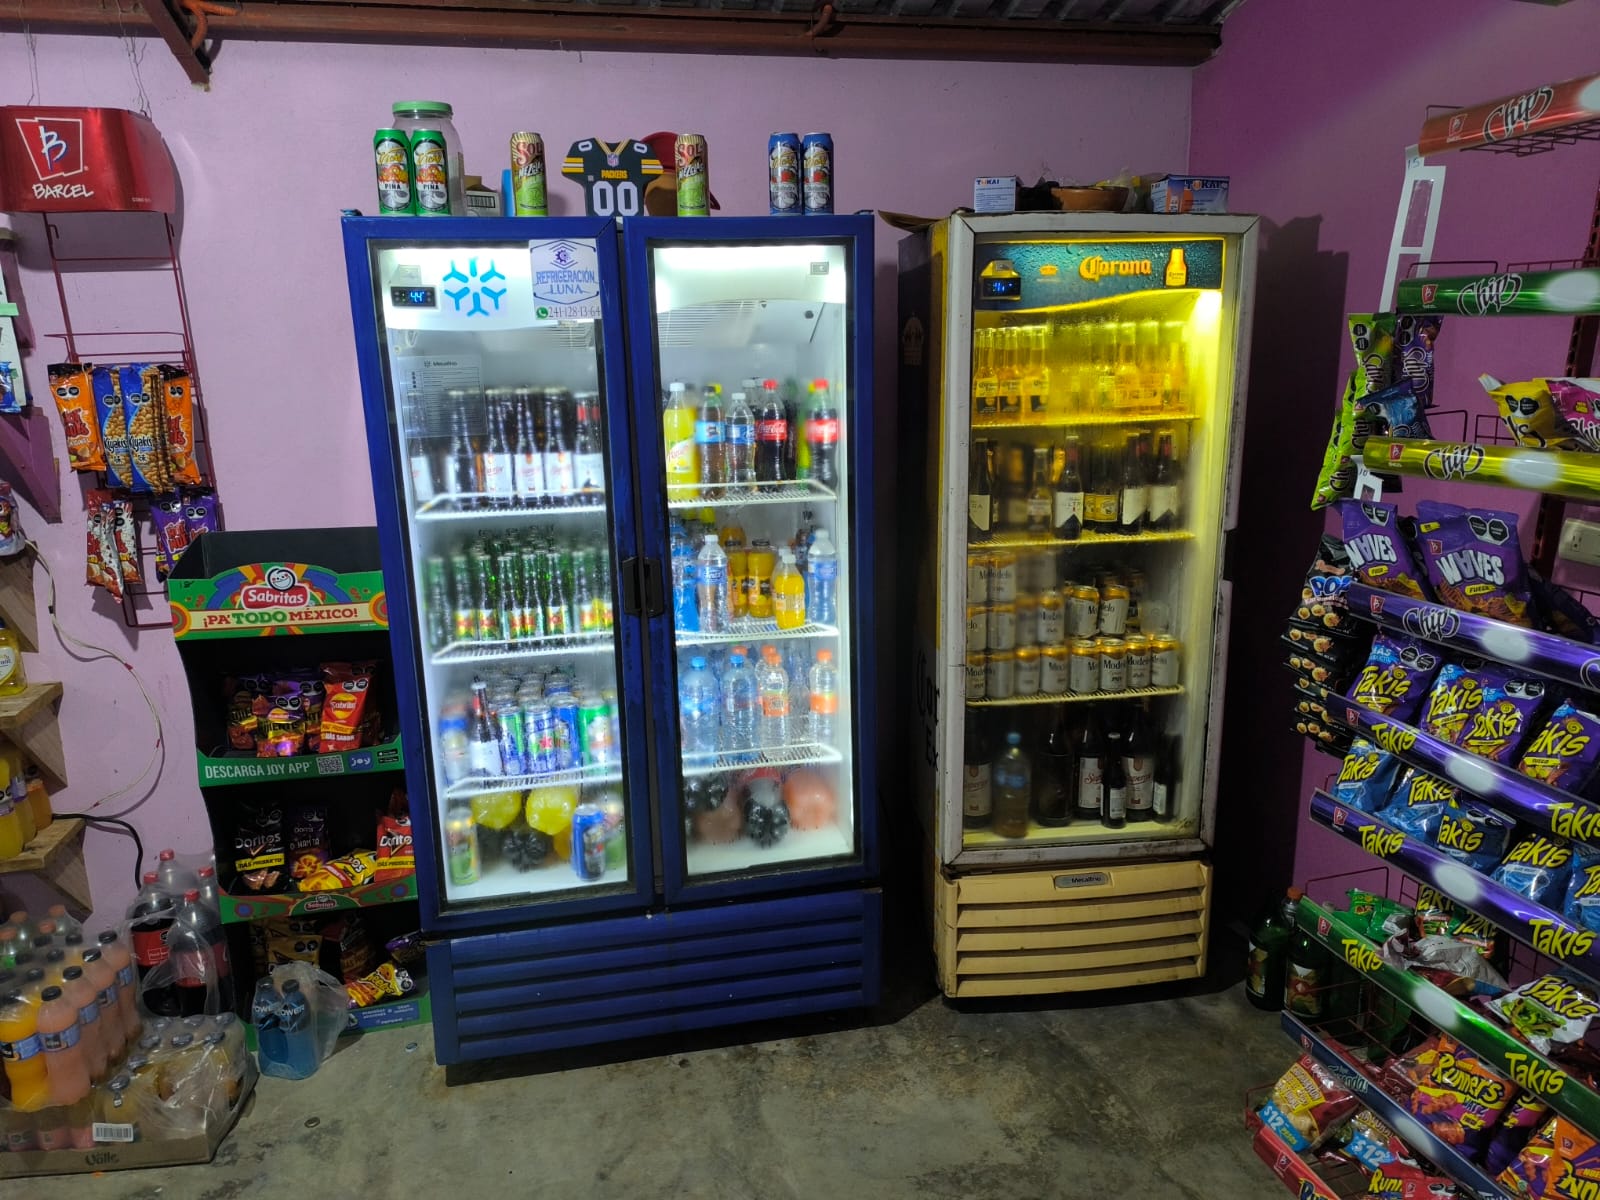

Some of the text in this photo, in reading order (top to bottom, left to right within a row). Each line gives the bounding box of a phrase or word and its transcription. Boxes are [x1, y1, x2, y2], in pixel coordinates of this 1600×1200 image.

[1483, 86, 1554, 143] Chips
[601, 168, 628, 179] PACKERS
[32, 183, 94, 199] BARCEL
[592, 181, 639, 217] 00
[536, 269, 595, 283] REFRIGERACIÓN
[1079, 255, 1152, 282] Corona
[550, 283, 584, 295] LUNA
[1457, 273, 1522, 316] Chips
[128, 436, 153, 451] Kiyakis
[1424, 444, 1486, 480] Chips
[1344, 533, 1398, 570] WAVES
[1436, 549, 1504, 586] WAVES
[247, 589, 304, 605] Sabritas
[231, 610, 288, 625] TODO
[289, 606, 358, 622] MÉXICO!
[1402, 607, 1461, 641] Chips
[1353, 665, 1412, 698] Takis
[1427, 682, 1483, 723] Takis
[1370, 723, 1417, 755] Takis
[204, 760, 311, 780] DESCARGA JOY APP
[350, 756, 371, 768] joy
[1336, 752, 1380, 784] Takis
[235, 833, 282, 850] Doritos
[1359, 825, 1405, 858] Takis
[1341, 939, 1384, 972] Takis
[1529, 919, 1599, 960] Takis
[1519, 975, 1599, 1019] Takis
[1431, 1052, 1504, 1103] Runners
[1504, 1052, 1568, 1094] Takis
